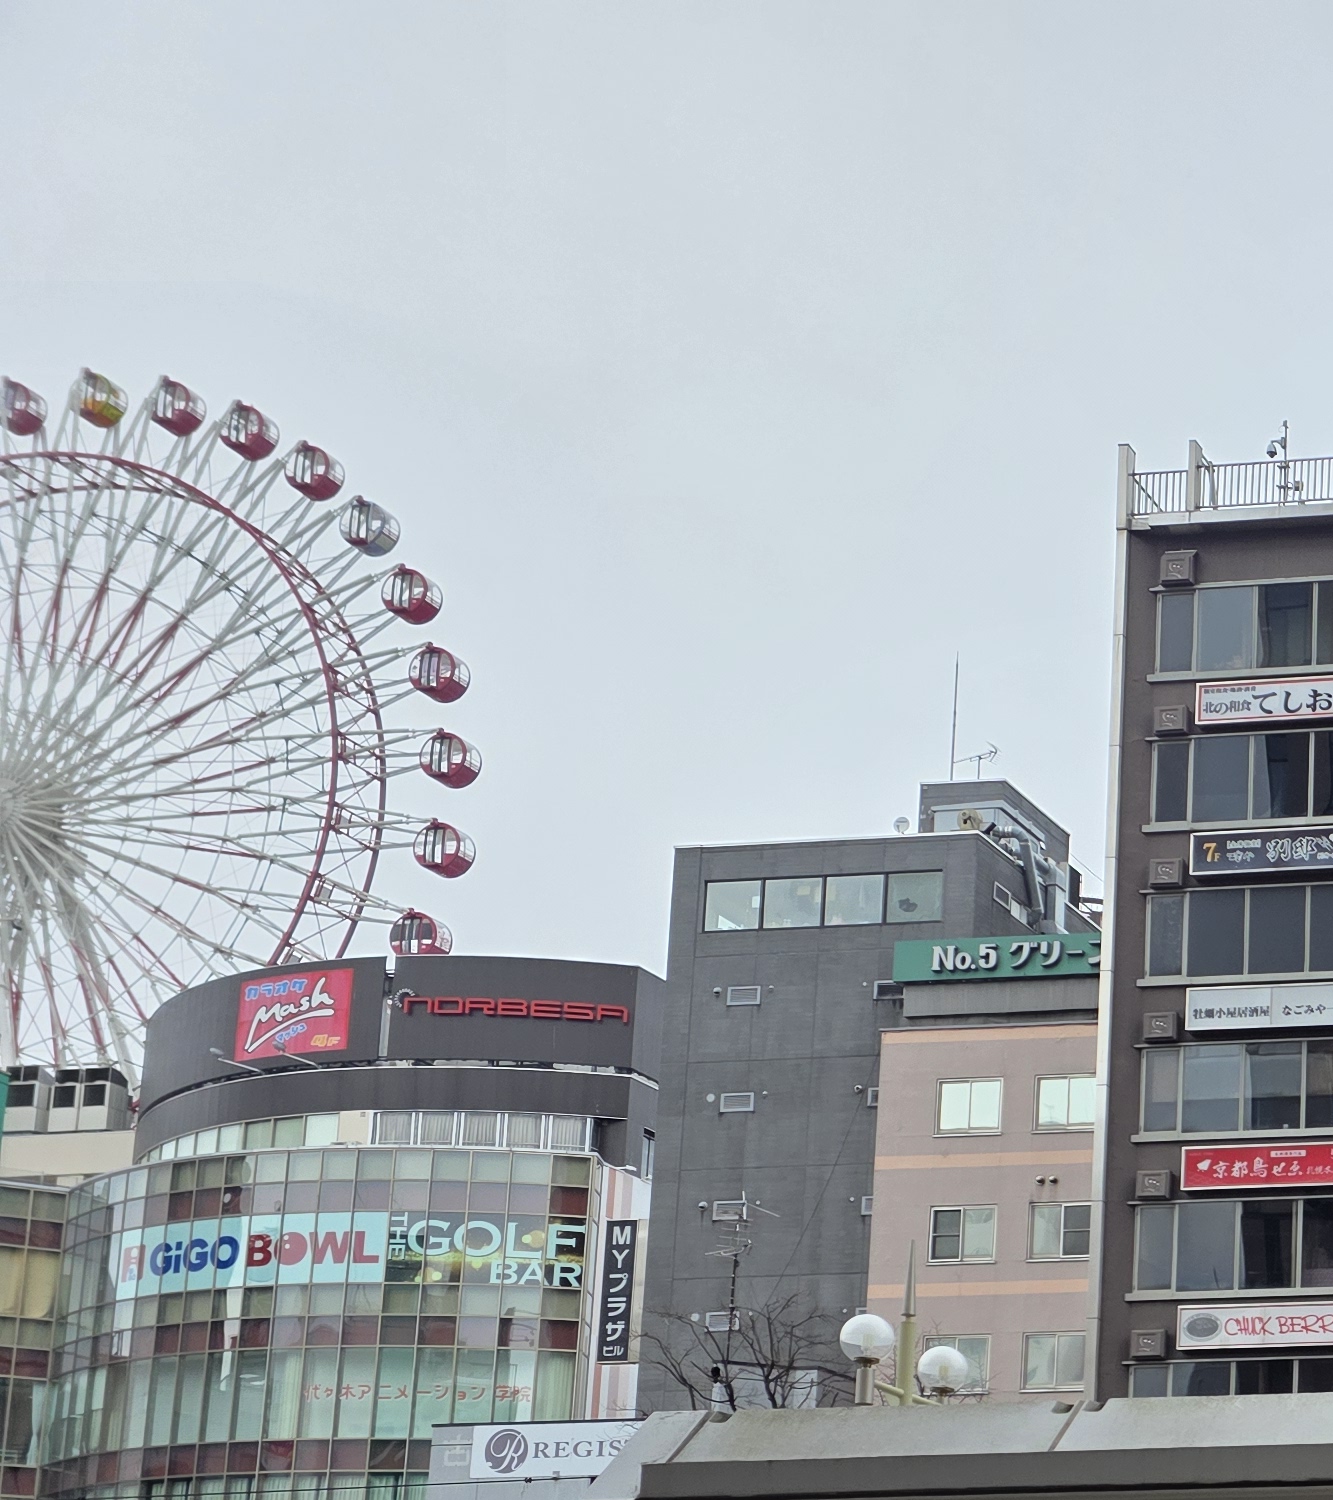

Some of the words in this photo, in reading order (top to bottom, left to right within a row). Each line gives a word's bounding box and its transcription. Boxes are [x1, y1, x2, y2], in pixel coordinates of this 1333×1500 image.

[1203, 699, 1251, 715] 北の和食
[1252, 688, 1333, 714] てしお
[1203, 842, 1221, 862] 7F
[931, 945, 998, 972] No.5
[245, 979, 308, 1000] カラオケ
[244, 977, 334, 1053] Mash
[403, 996, 629, 1024] NORBESA
[311, 1034, 341, 1048] 4F
[392, 1213, 409, 1260] THE
[410, 1219, 586, 1259] GOLF
[149, 1235, 240, 1277] GiGO
[246, 1230, 379, 1267] BOWL
[490, 1262, 582, 1288] BAR
[602, 1225, 632, 1357] MYプラザビル
[1224, 1316, 1274, 1336] CHUCK
[532, 1439, 628, 1459] REGIS
